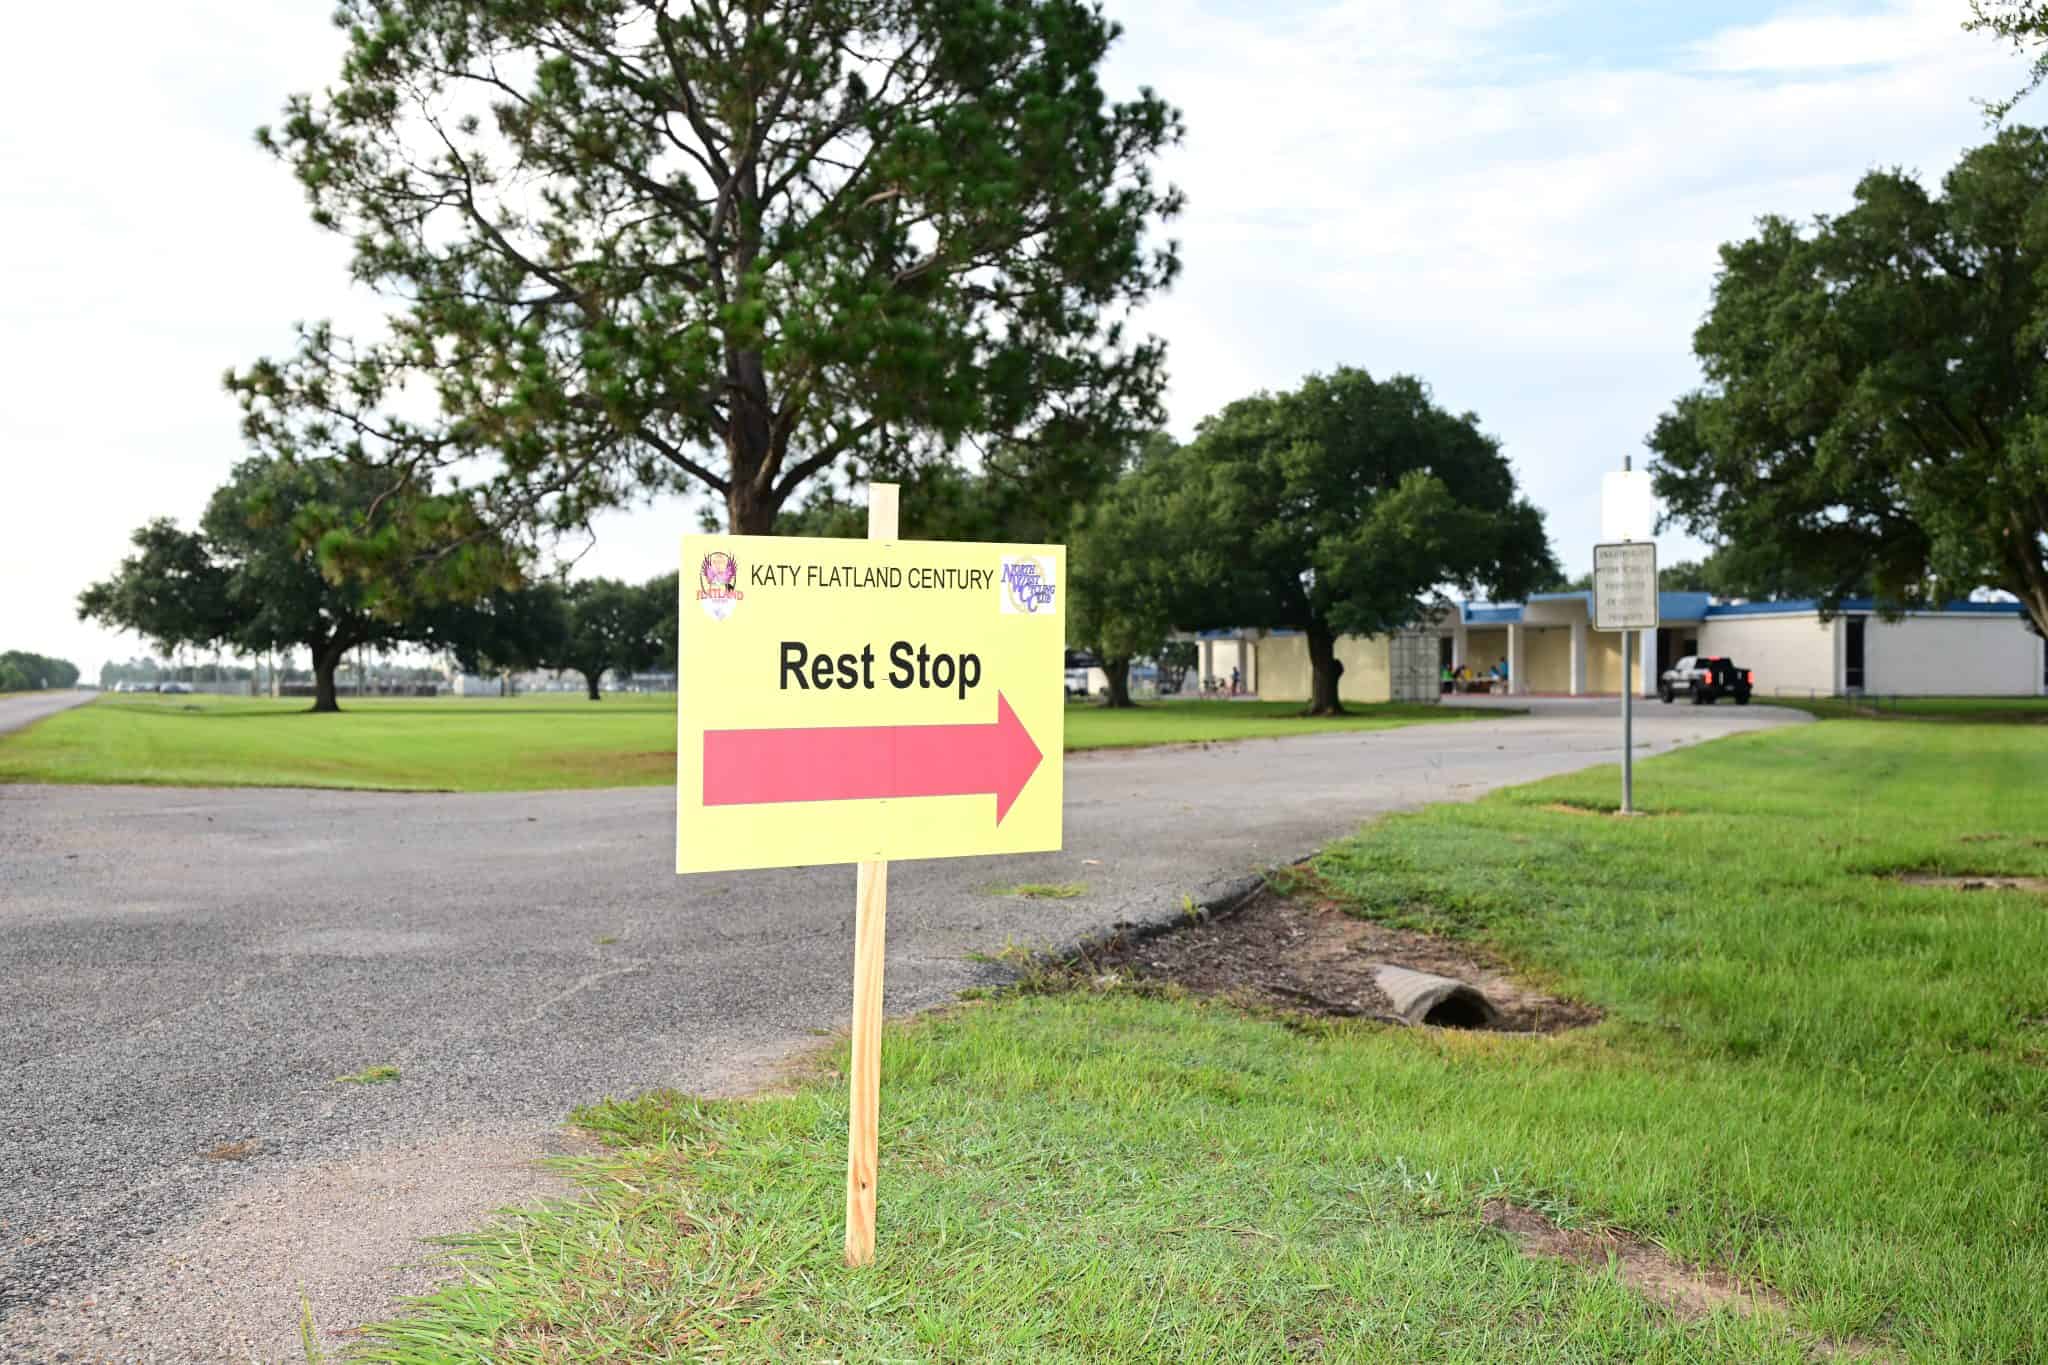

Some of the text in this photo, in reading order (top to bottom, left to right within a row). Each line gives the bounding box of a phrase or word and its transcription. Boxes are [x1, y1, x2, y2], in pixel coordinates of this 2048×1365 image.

[750, 564, 994, 590] KATY FLATLAND CENTURY
[780, 641, 982, 700] Rest Stop
